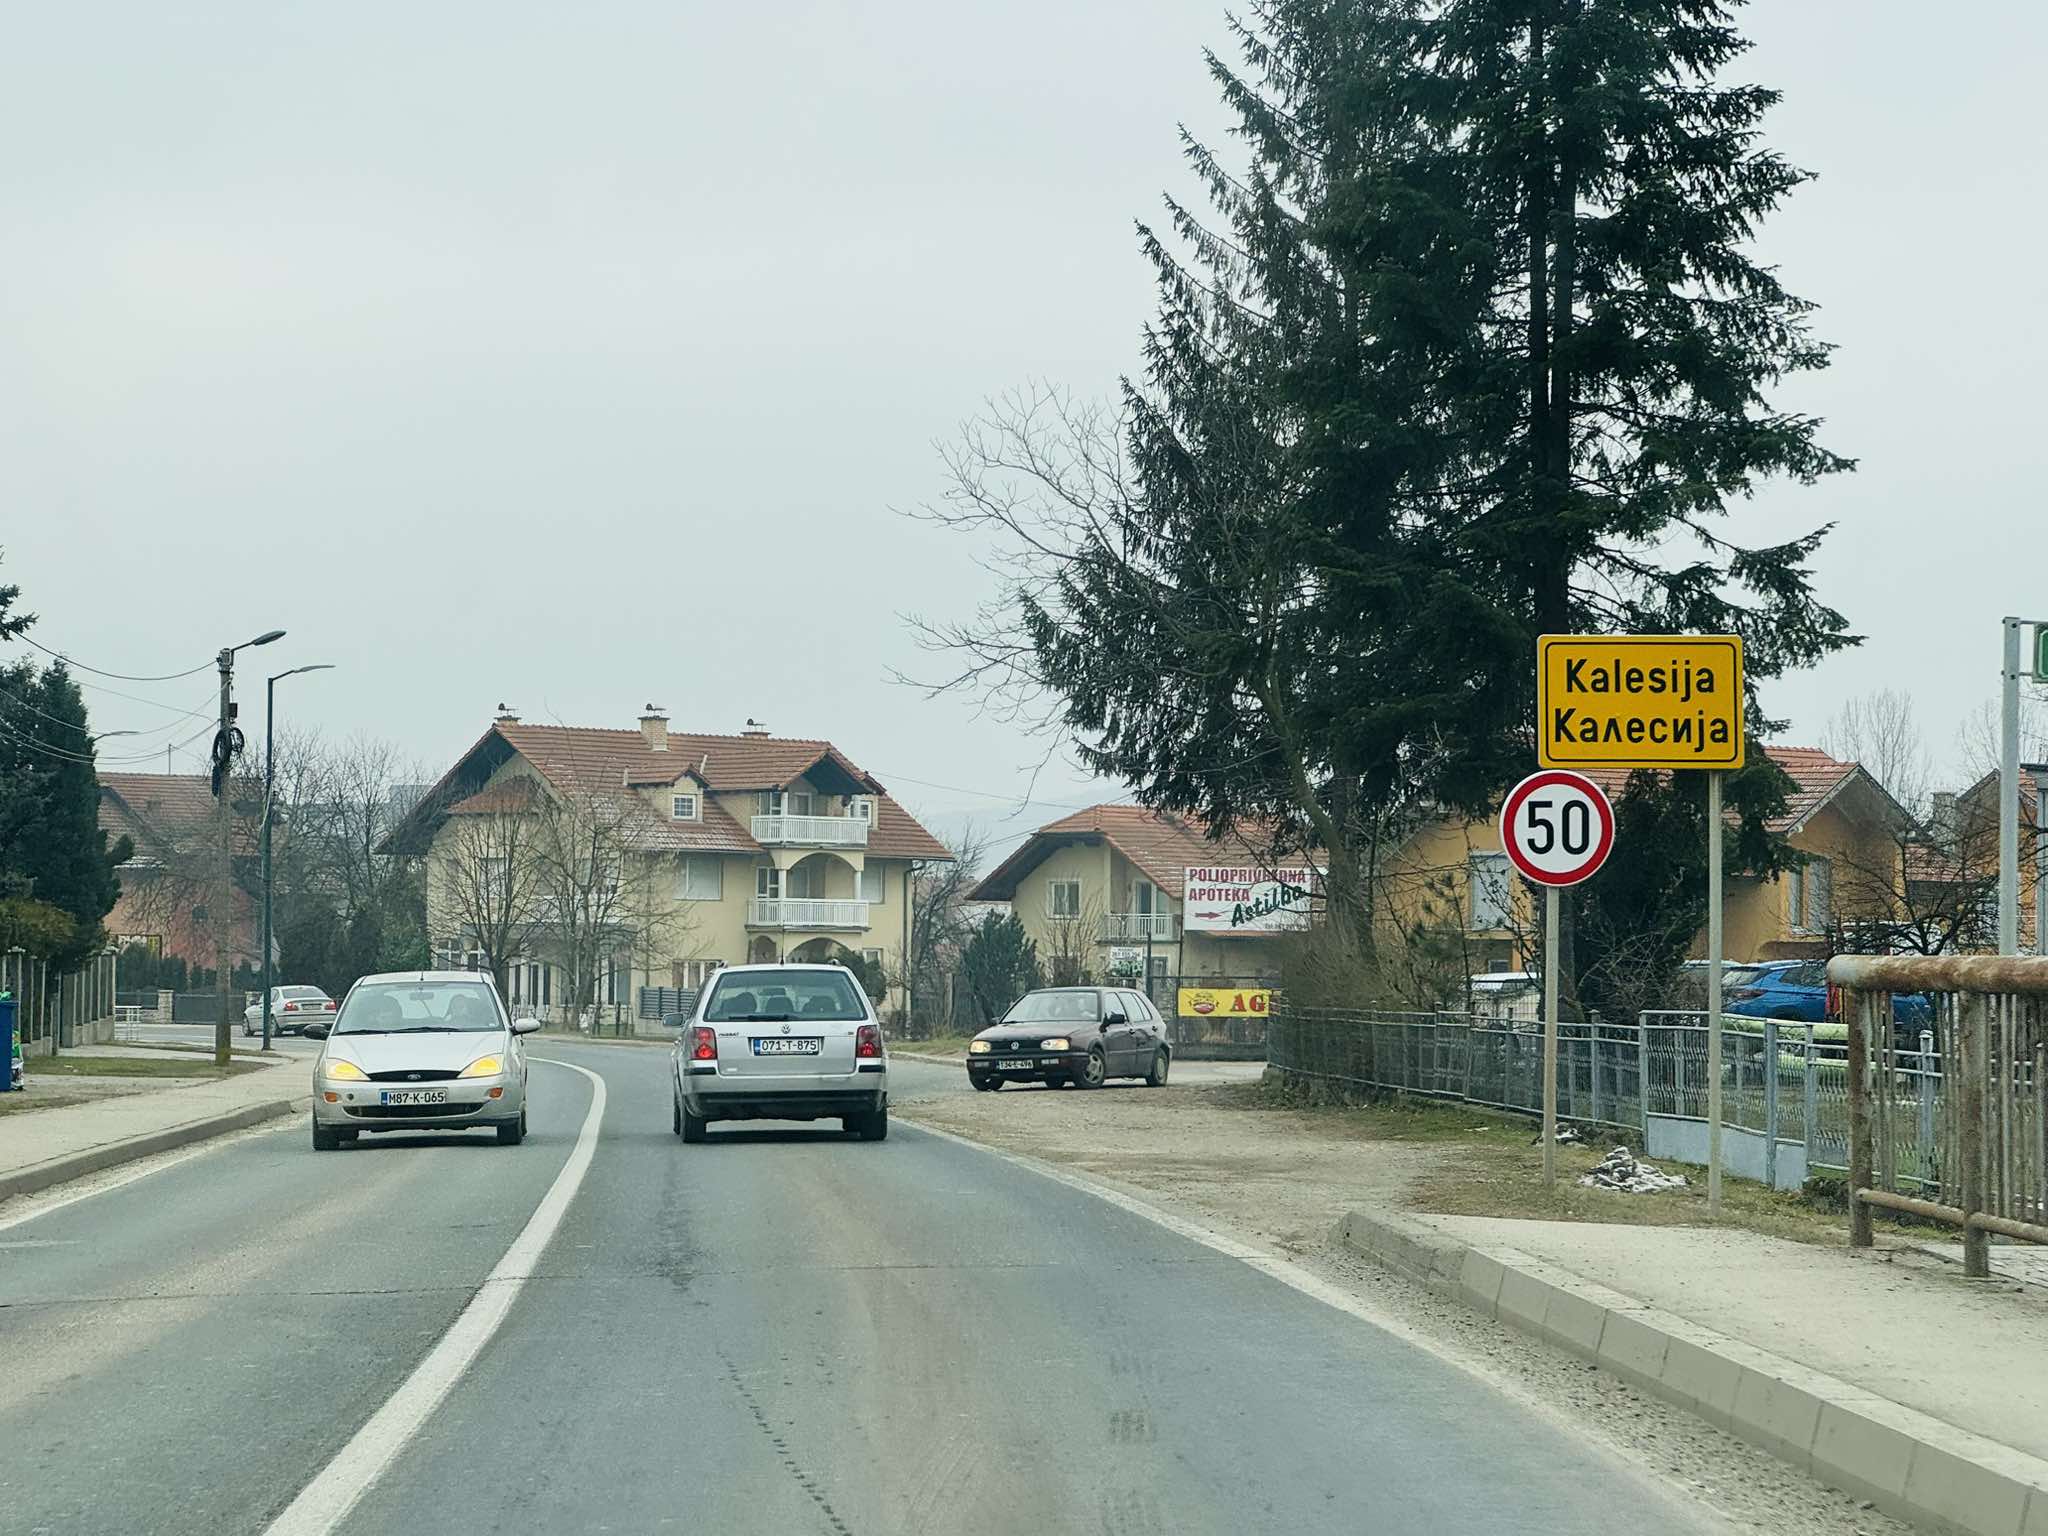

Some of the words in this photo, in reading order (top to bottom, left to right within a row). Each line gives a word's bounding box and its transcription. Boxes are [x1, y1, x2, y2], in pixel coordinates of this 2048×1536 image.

[1566, 659, 1715, 702] Kalesija
[1554, 708, 1729, 753] Калесија
[1527, 800, 1590, 855] 50
[1189, 888, 1250, 902] APOTEKA
[762, 1040, 817, 1051] 071-T-875
[389, 1092, 445, 1104] M87-K-065
